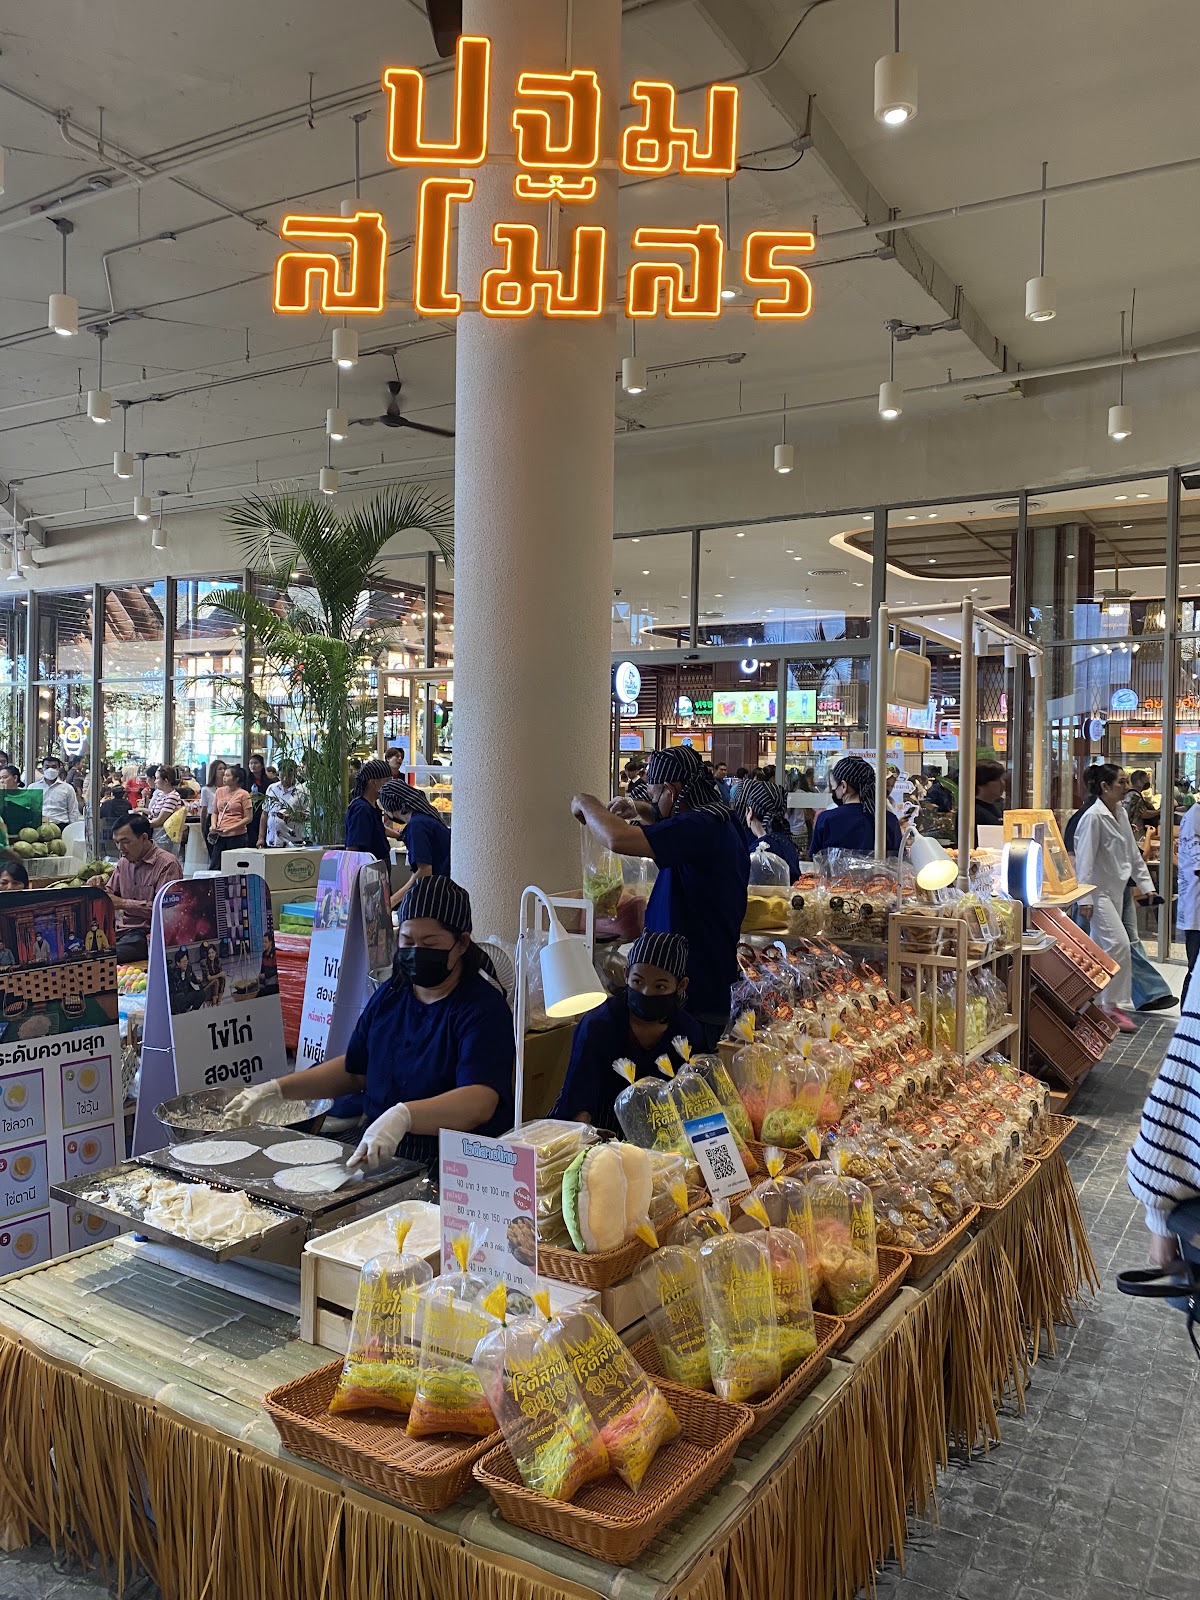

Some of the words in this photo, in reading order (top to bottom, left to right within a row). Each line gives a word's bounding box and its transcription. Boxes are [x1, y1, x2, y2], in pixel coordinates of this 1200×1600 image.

[382, 35, 739, 200] ปฐม
[273, 177, 817, 319] สโมสร
[208, 1014, 253, 1050] ไข่ไก่
[204, 1055, 263, 1085] สองลูก
[2, 1117, 34, 1133] ไข่ลวก
[457, 1179, 463, 1188] 40
[491, 1213, 500, 1223] 150
